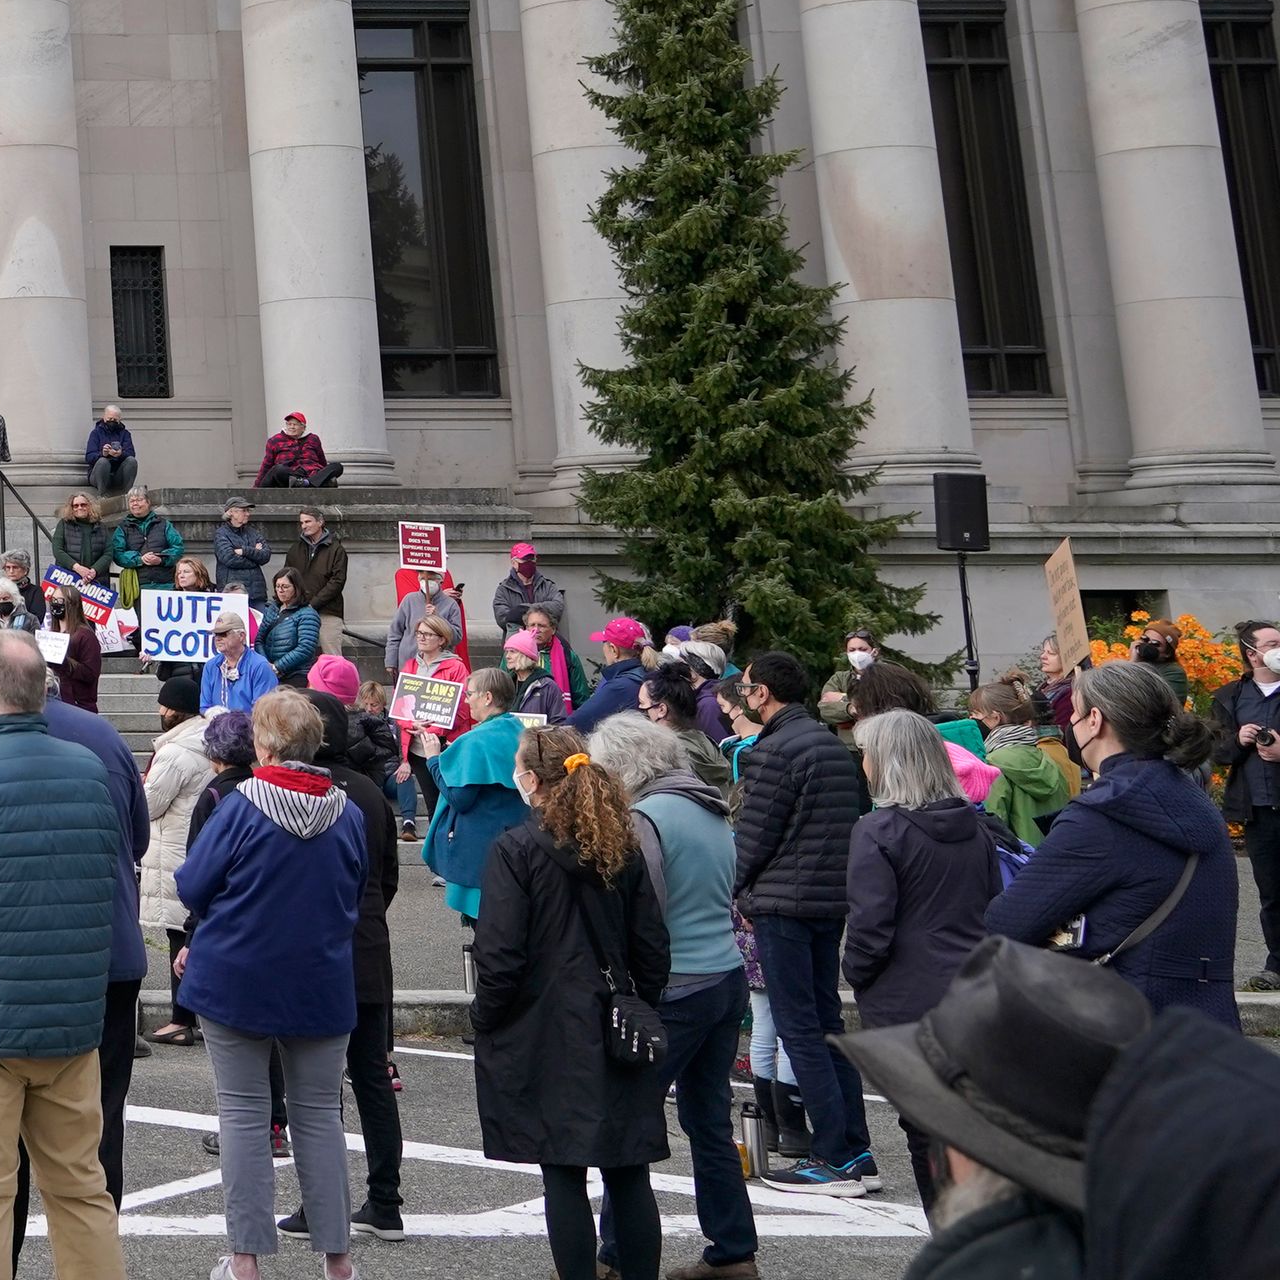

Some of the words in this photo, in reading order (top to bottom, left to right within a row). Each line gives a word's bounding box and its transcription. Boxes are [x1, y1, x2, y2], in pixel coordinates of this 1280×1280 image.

[50, 568, 113, 604] PRO-CHOICE
[157, 596, 223, 624] WTF
[425, 681, 456, 698] LAWS
[415, 710, 451, 724] PREGNANT?
